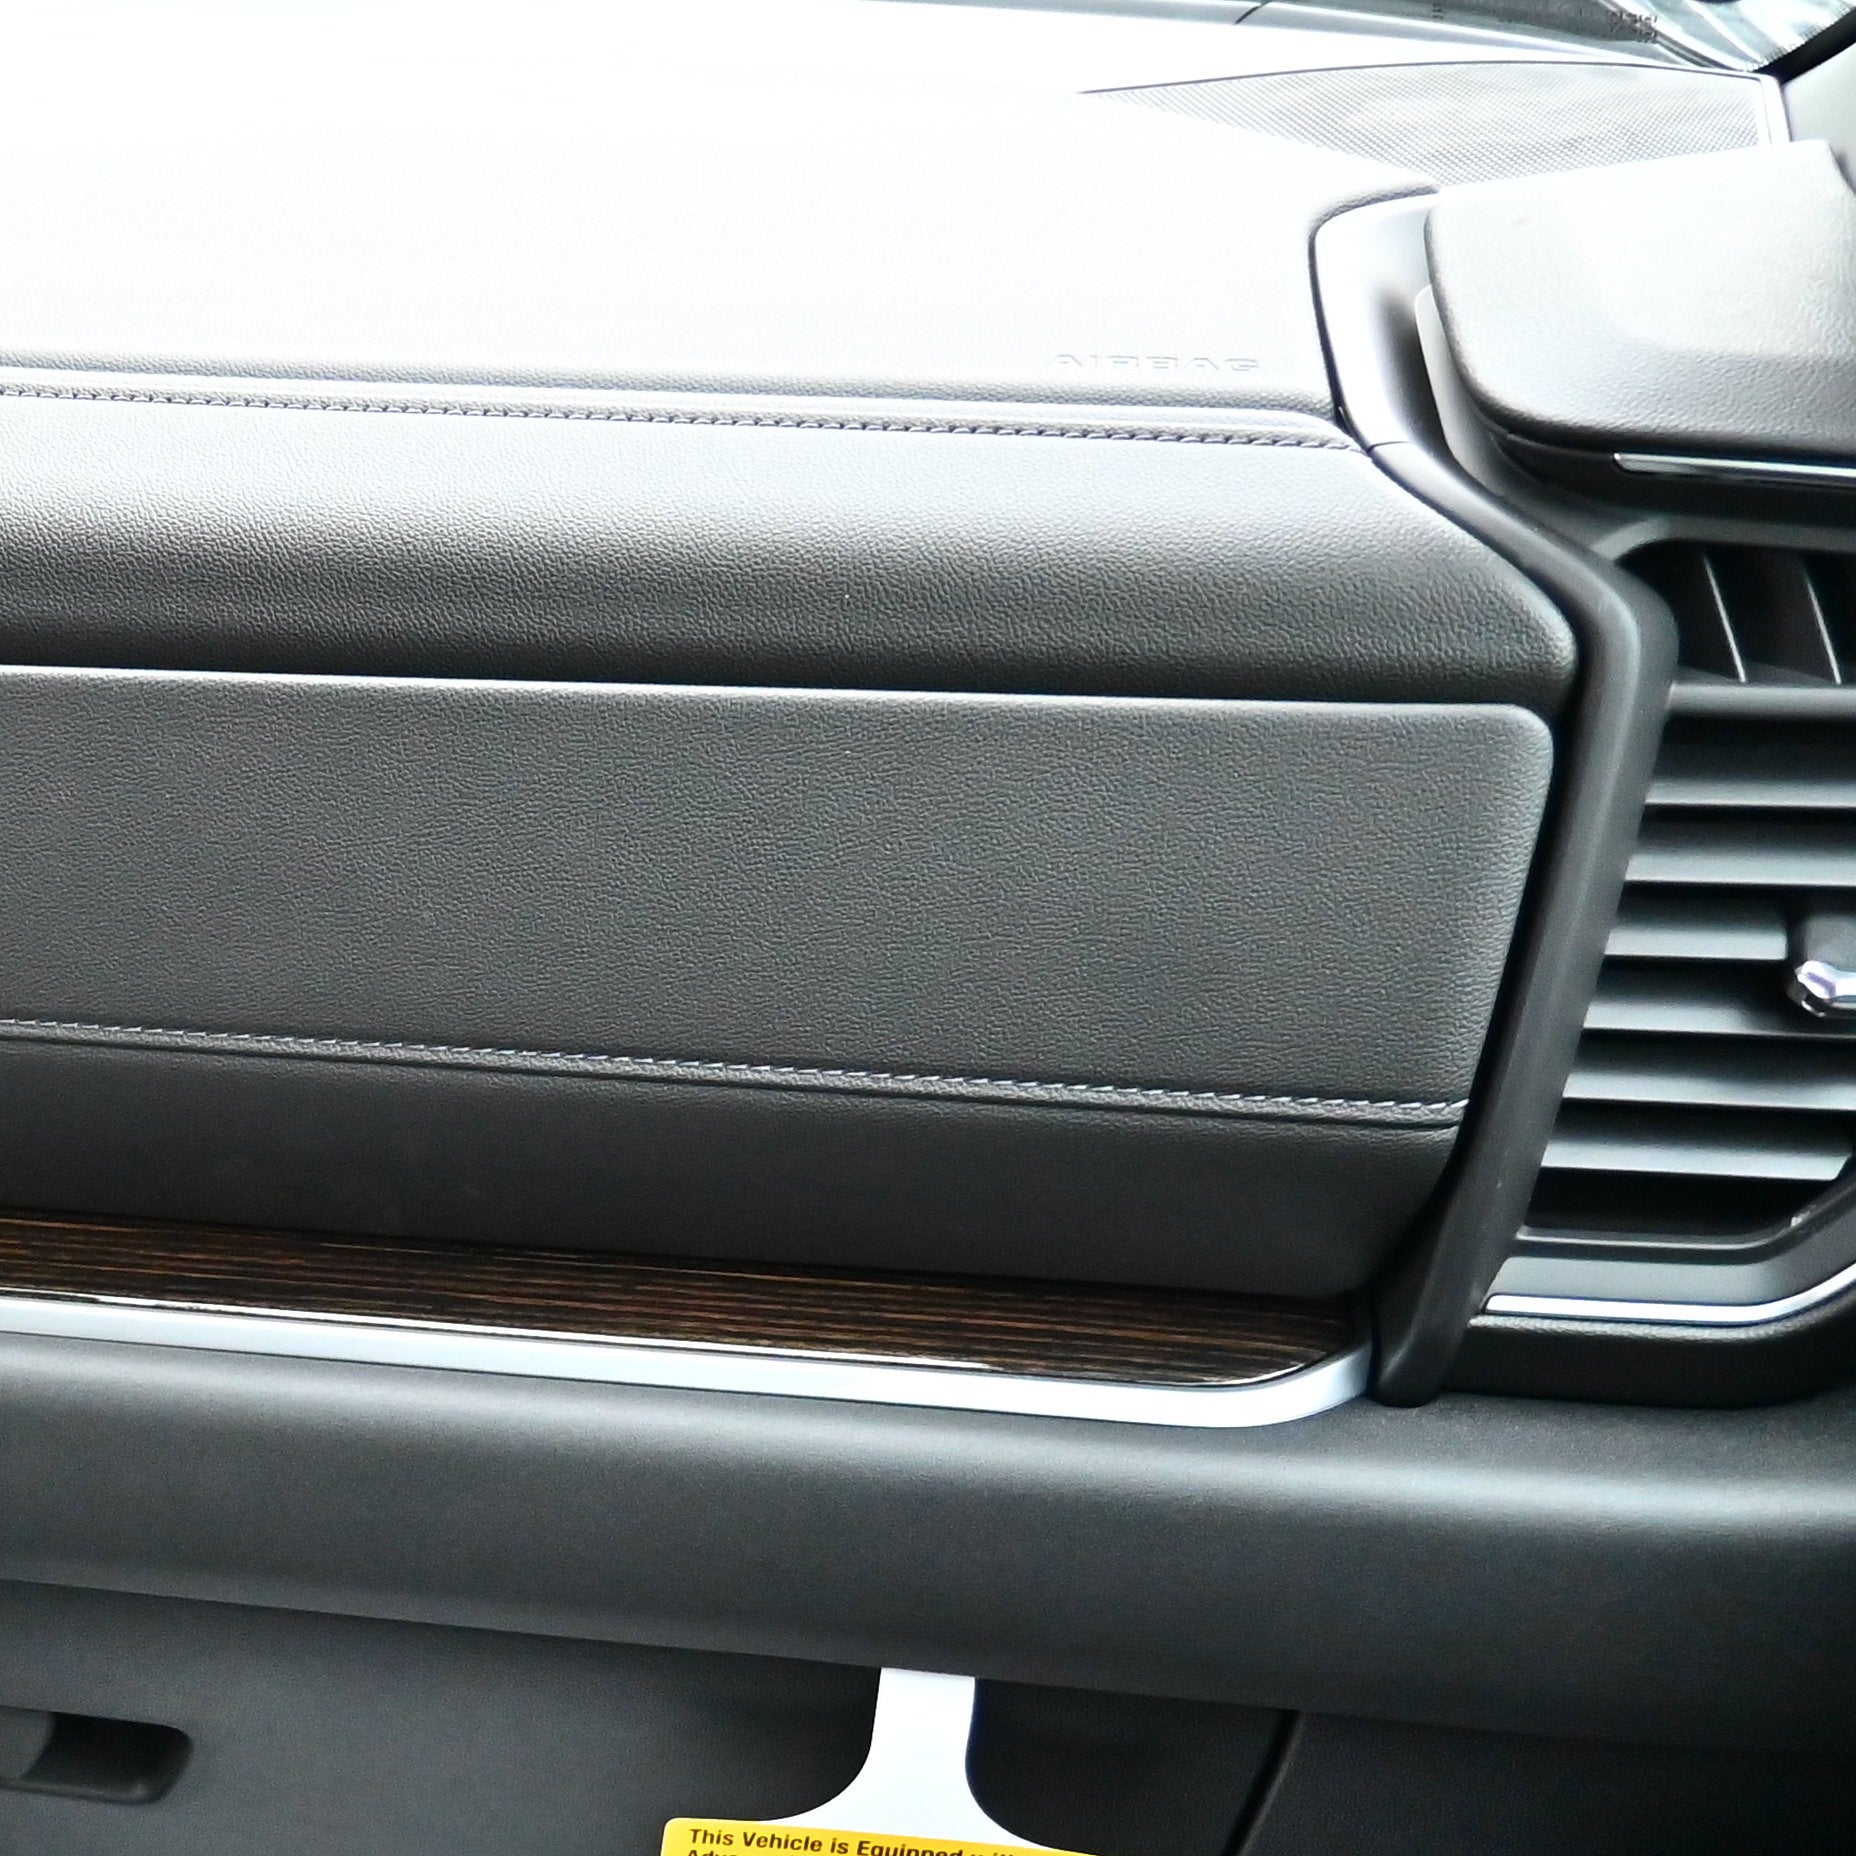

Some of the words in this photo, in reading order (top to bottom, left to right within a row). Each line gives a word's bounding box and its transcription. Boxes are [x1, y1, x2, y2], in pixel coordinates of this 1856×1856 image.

[1047, 352, 1261, 373] AIRBAG
[689, 1828, 734, 1847] This
[743, 1831, 823, 1853] Vehicle
[830, 1837, 849, 1855] is
